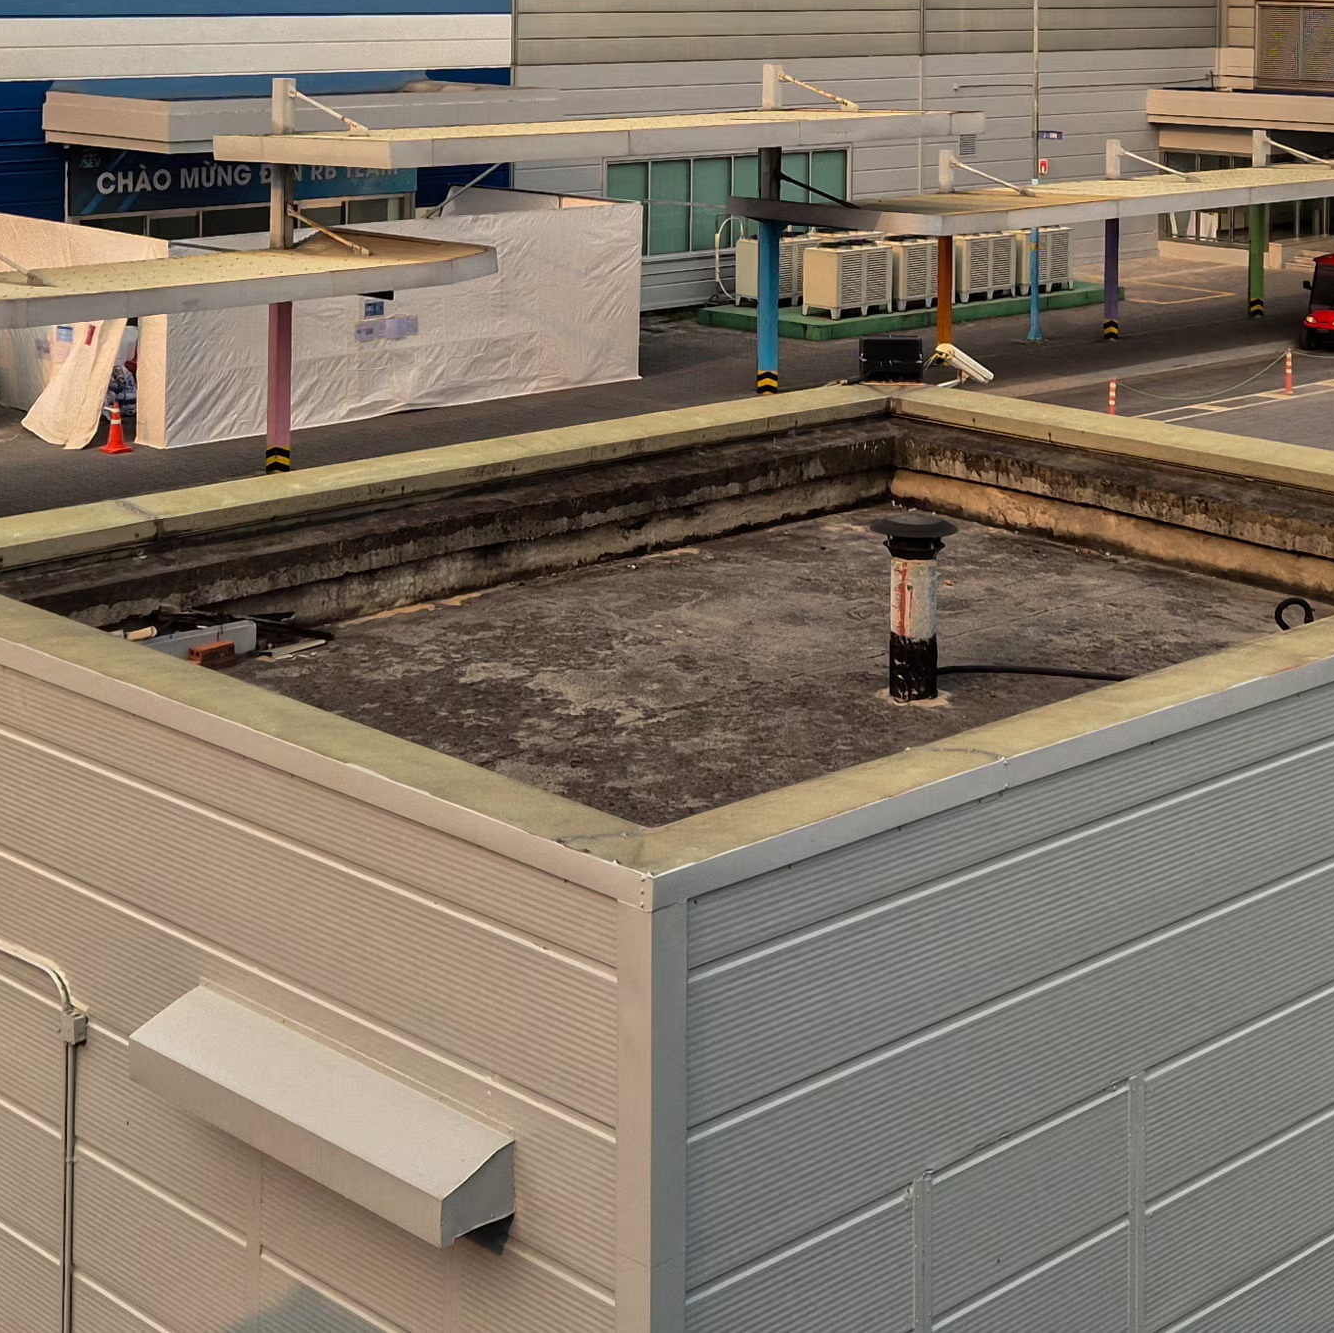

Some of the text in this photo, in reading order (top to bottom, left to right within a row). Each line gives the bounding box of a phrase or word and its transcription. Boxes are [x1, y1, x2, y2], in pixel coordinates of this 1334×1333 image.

[96, 164, 172, 195] CHÀO
[180, 160, 252, 189] MỪNG
[259, 163, 303, 184] ĐN
